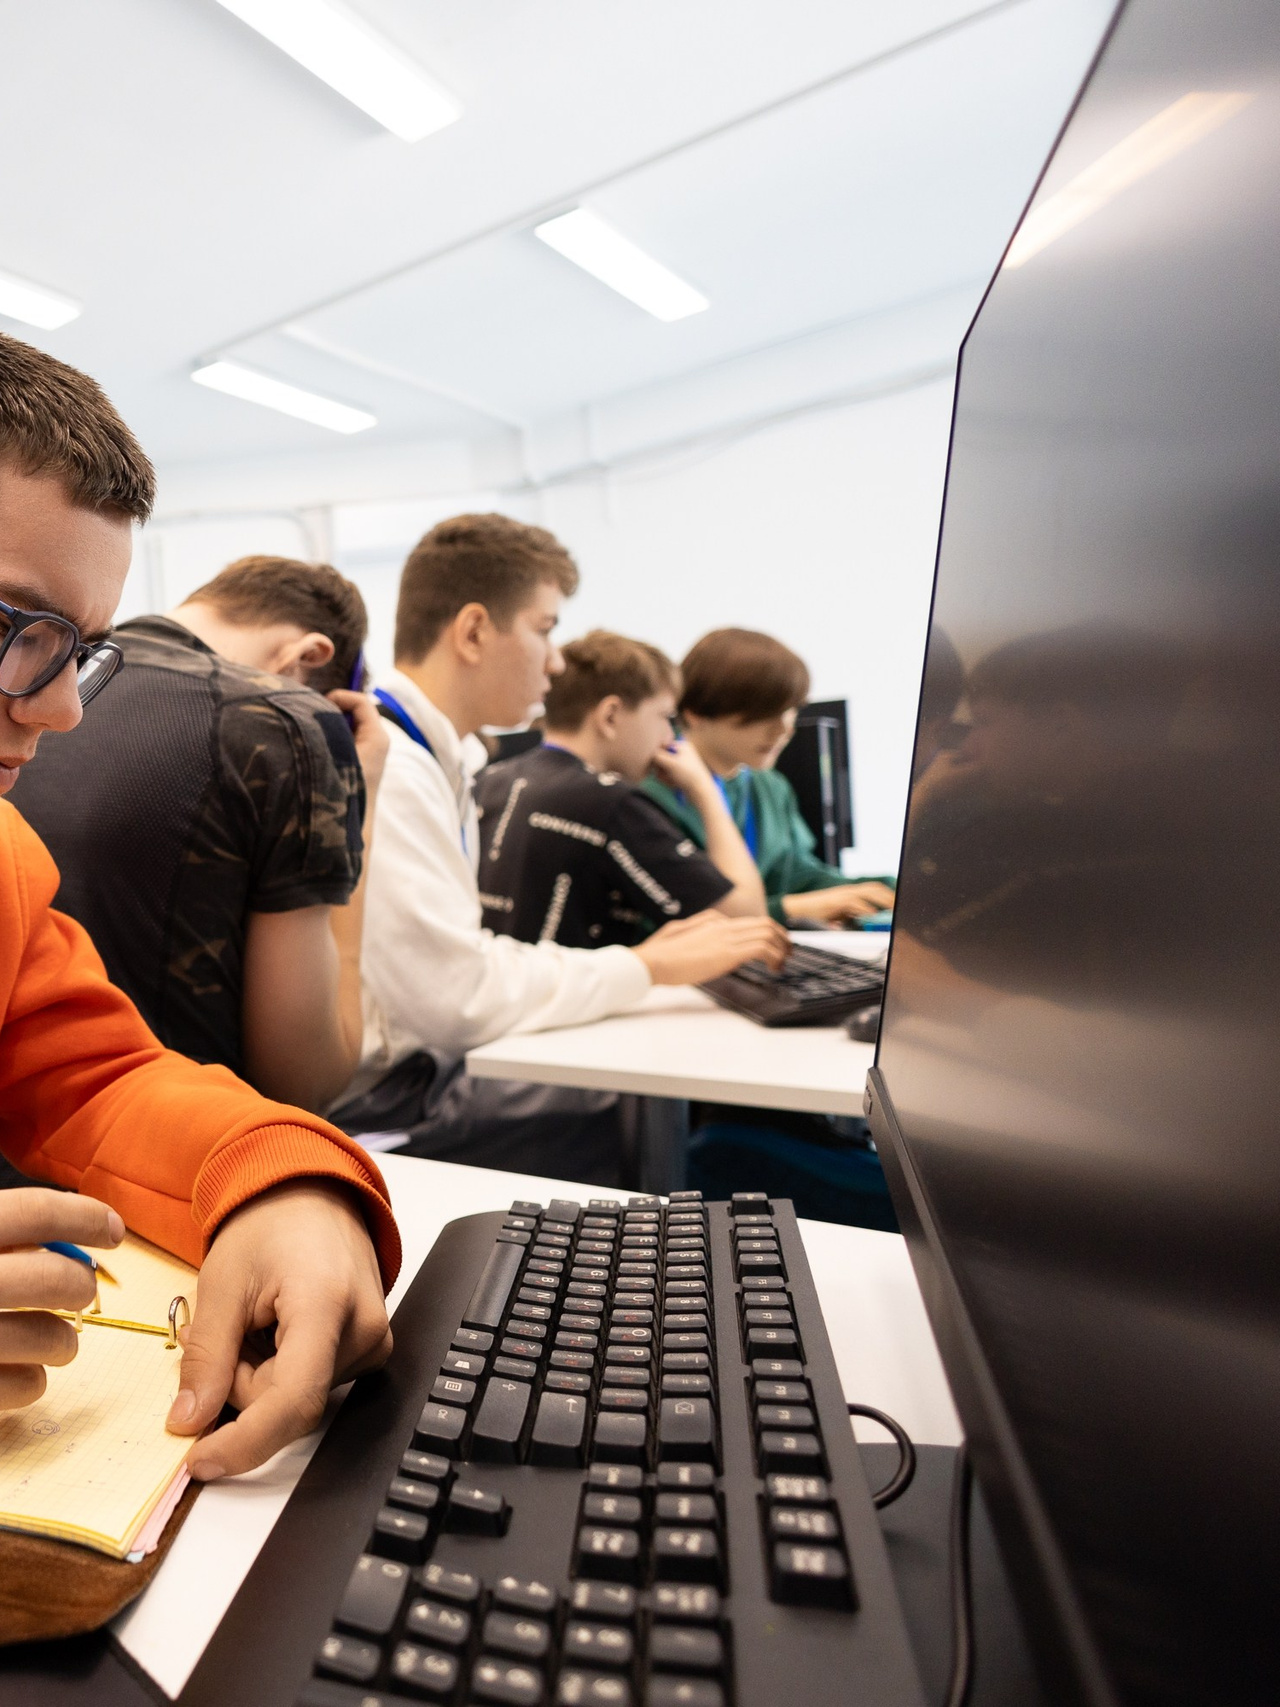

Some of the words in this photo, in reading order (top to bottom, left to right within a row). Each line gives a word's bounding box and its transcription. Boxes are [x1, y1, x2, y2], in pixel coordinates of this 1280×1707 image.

[537, 1291, 551, 1299] N
[531, 1306, 546, 1315] M
[762, 1312, 772, 1320] F7
[631, 1329, 647, 1337] O
[438, 1609, 464, 1629] 2
